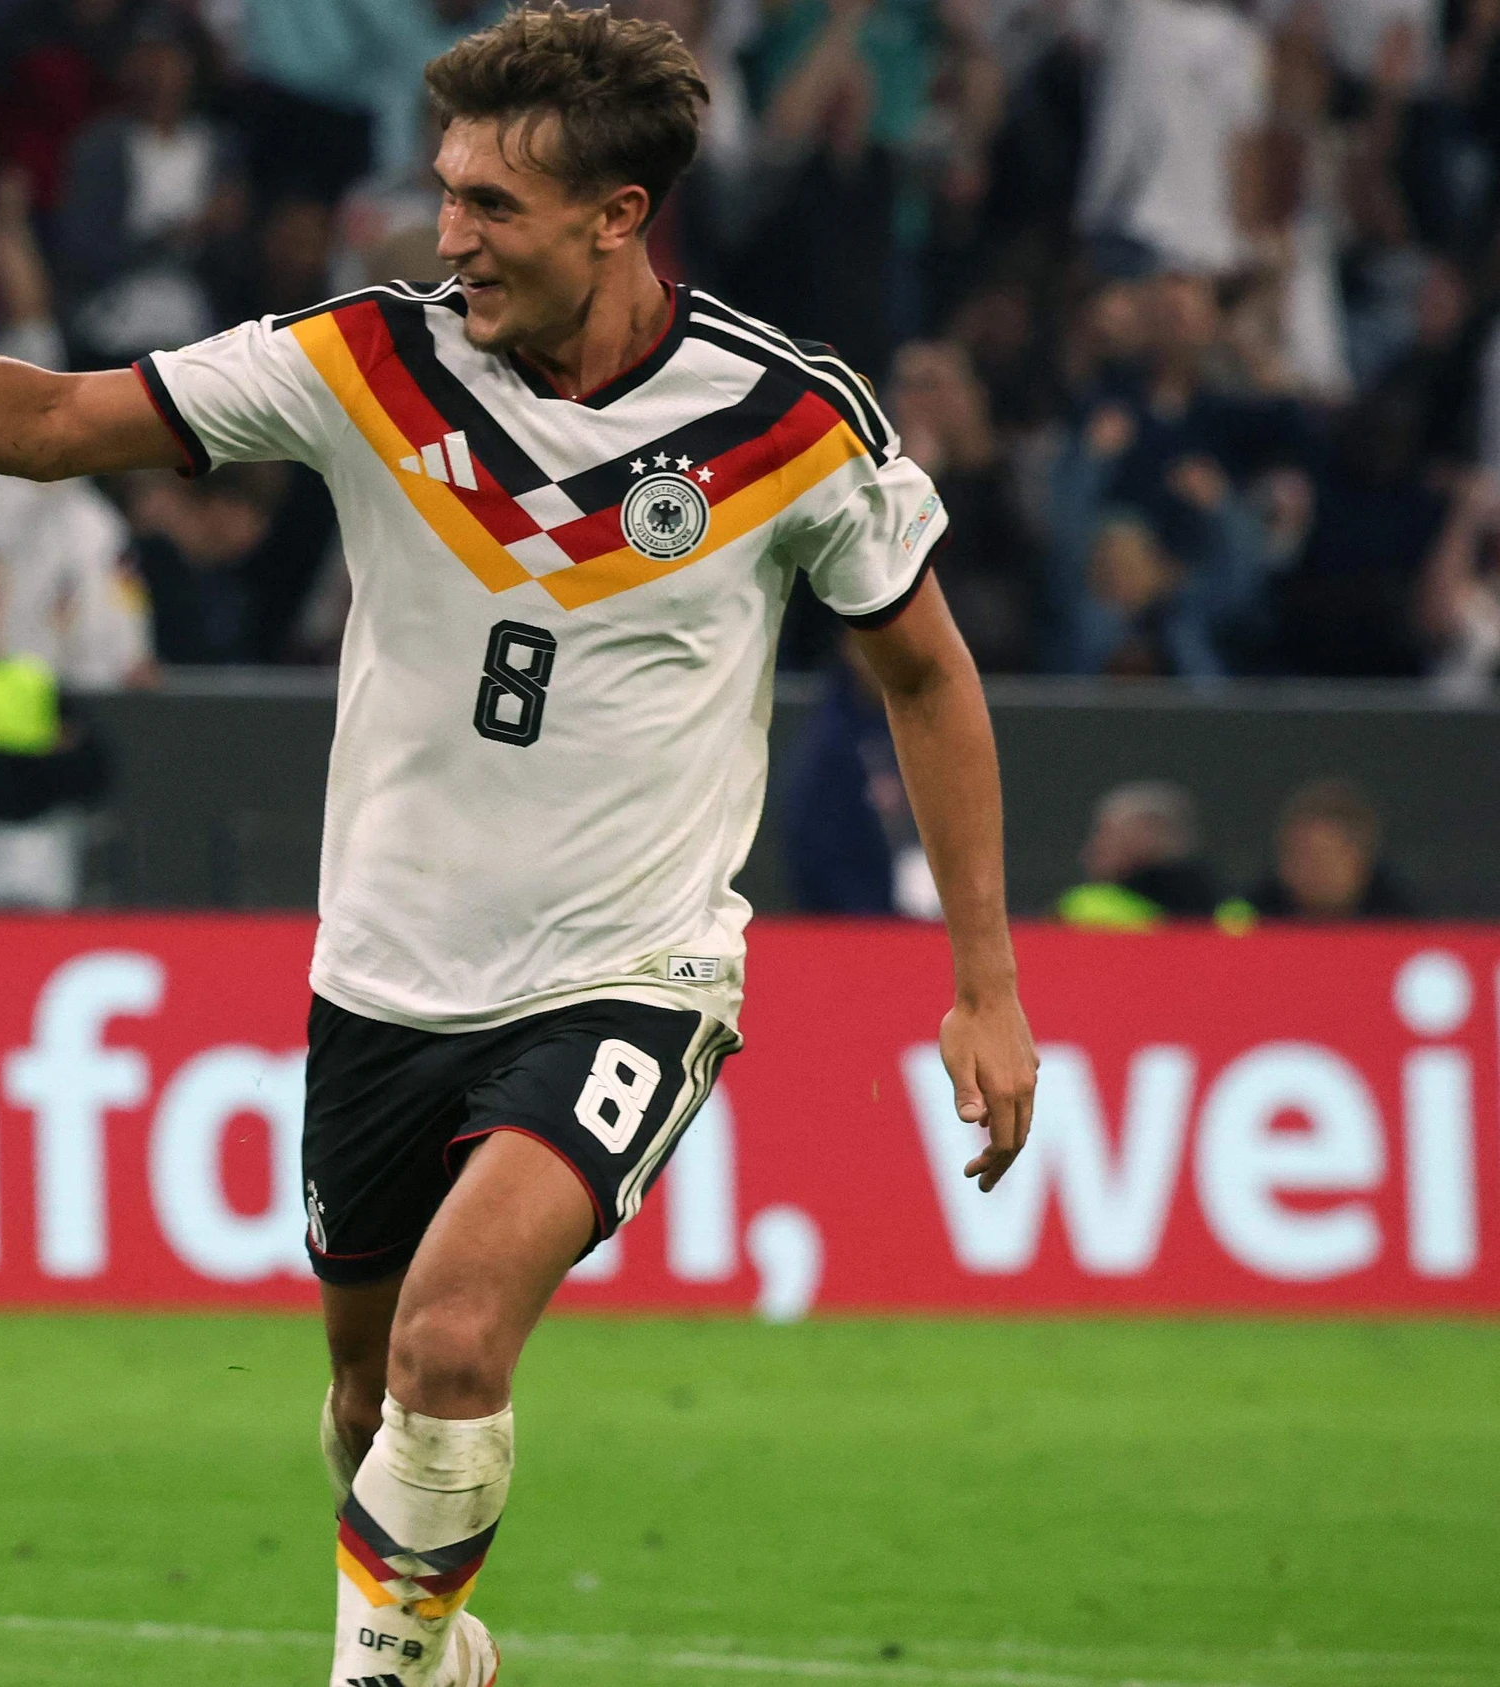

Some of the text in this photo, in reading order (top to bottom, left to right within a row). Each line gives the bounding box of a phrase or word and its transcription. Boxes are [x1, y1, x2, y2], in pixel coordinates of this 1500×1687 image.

[473, 619, 558, 748] 8
[573, 1038, 662, 1154] 8
[900, 947, 1500, 1281] wei
[359, 1627, 424, 1659] DFB
